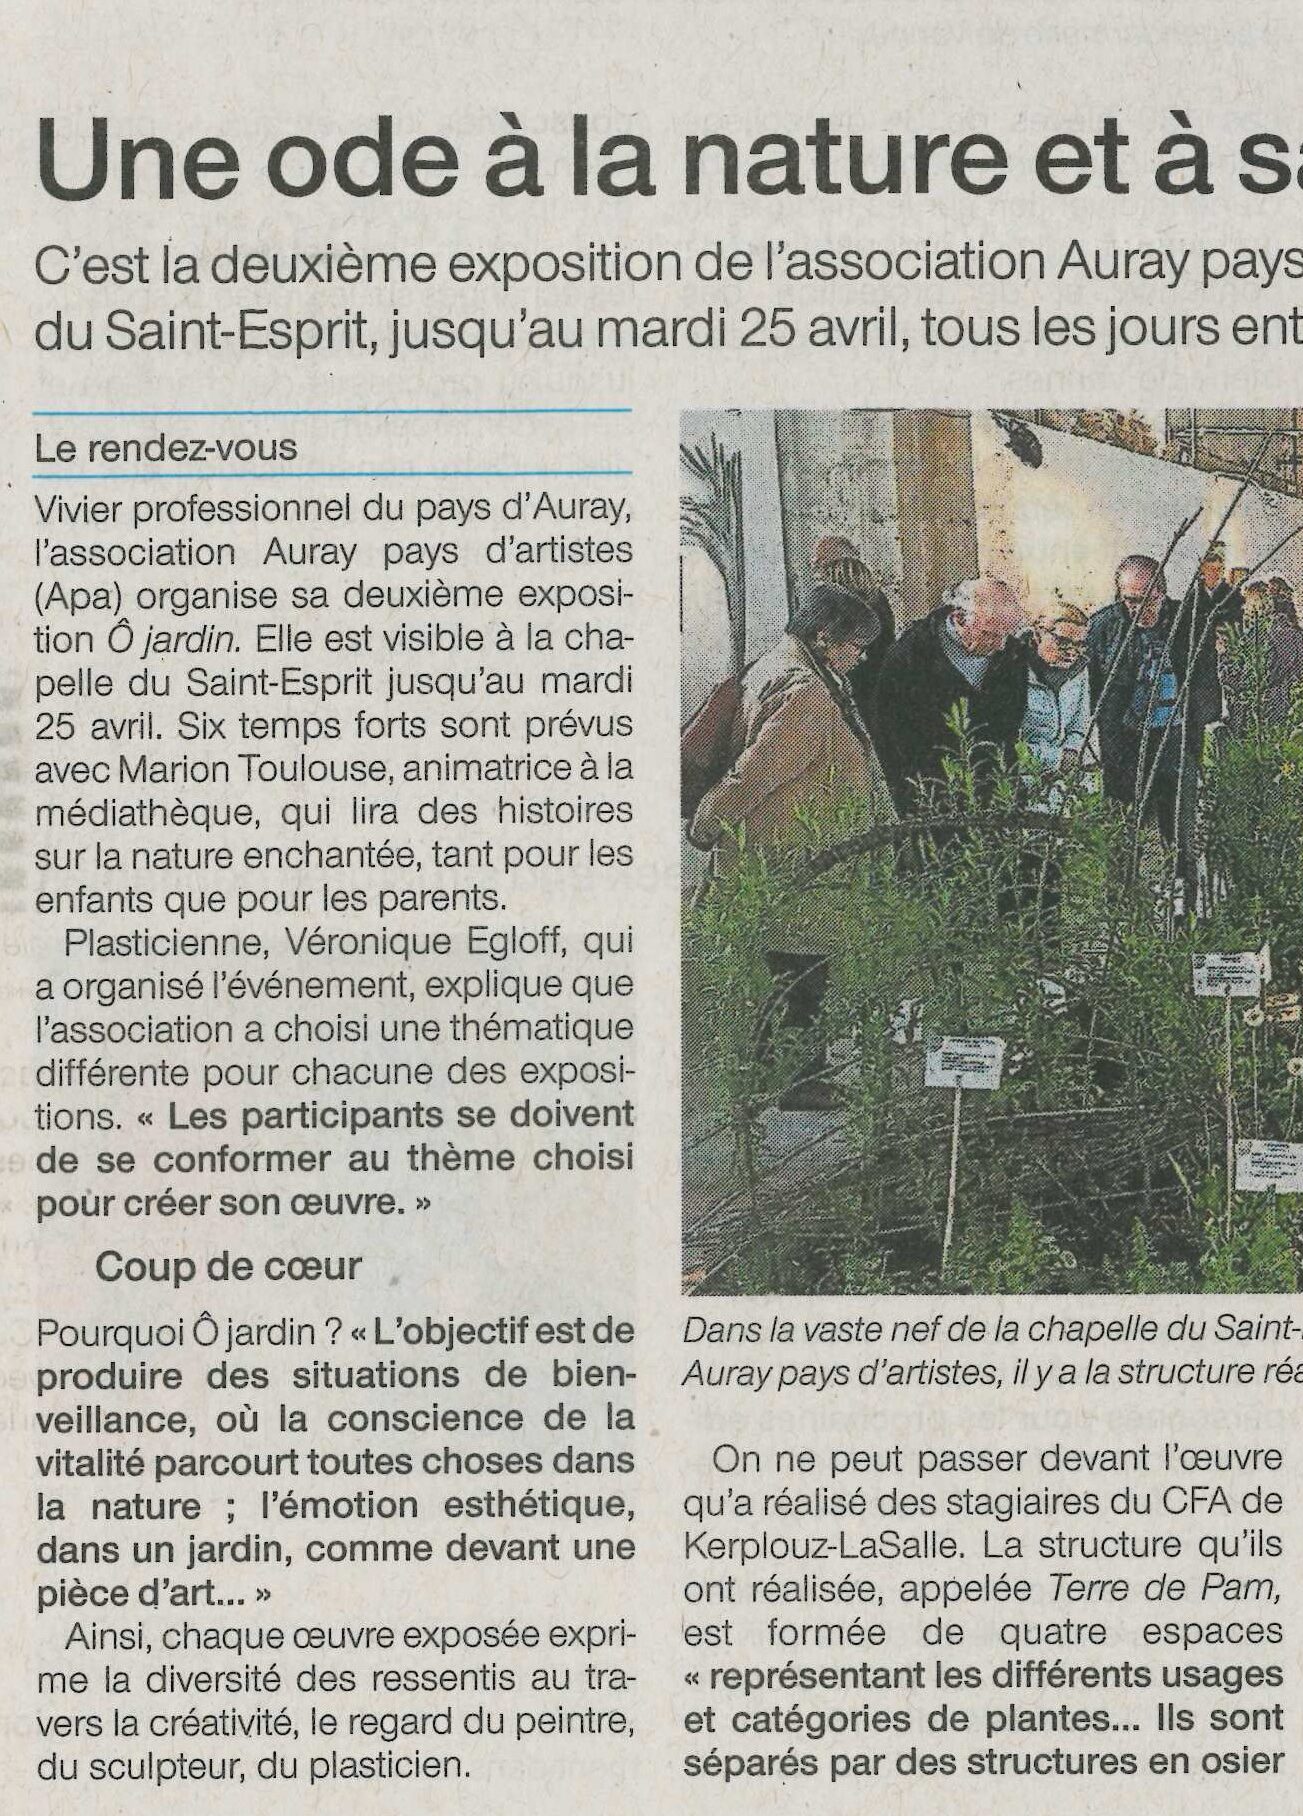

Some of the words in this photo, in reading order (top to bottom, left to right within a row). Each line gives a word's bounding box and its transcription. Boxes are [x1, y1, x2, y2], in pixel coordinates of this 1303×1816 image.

[39, 116, 240, 202] Une
[267, 114, 459, 198] ode
[485, 111, 545, 198] à
[573, 113, 657, 197] la
[685, 117, 1009, 196] nature
[1035, 117, 1130, 195] et
[1154, 109, 1215, 196] à
[35, 244, 150, 285] C'est
[163, 244, 200, 285] la
[211, 241, 437, 284] deuxième
[449, 241, 682, 292] exposition
[695, 241, 753, 281] de
[767, 239, 1045, 281] l'association
[1057, 239, 1191, 289] Auray
[35, 310, 92, 351] du
[106, 308, 378, 360] Saint-Esprit,
[388, 307, 583, 359] jusqu'au
[598, 306, 725, 348] mardi
[740, 306, 796, 347] 25
[809, 305, 909, 353] avril,
[920, 307, 1020, 347] tous
[1034, 305, 1096, 347] les
[1105, 305, 1220, 356] jours
[36, 433, 77, 463] Le
[89, 432, 298, 463] rendez-vous
[34, 494, 123, 523] Vivier
[134, 492, 350, 530] professionnel
[363, 492, 403, 521] du
[417, 498, 491, 528] pays
[502, 491, 631, 527] d'Auray,
[65, 927, 269, 961] Plasticienne,
[284, 925, 452, 962] Véronique
[468, 925, 567, 962] Egloff,
[583, 925, 633, 960] qui
[36, 1057, 189, 1087] différente
[204, 1064, 280, 1093] pour
[292, 1057, 433, 1086] chacune
[447, 1055, 507, 1085] des
[520, 1054, 636, 1091] exposi-
[95, 1250, 197, 1289] Coup
[207, 1250, 254, 1282] de
[264, 1256, 363, 1281] cœur
[683, 1316, 762, 1343] Dans
[769, 1315, 795, 1343] la
[804, 1316, 883, 1343] vaste
[890, 1314, 943, 1342] nef
[948, 1314, 986, 1342] de
[994, 1314, 1019, 1342] la
[1028, 1314, 1159, 1348] chapelle
[1167, 1313, 1207, 1341] du
[37, 1361, 183, 1397] produire
[206, 1360, 269, 1390] des
[293, 1359, 460, 1389] situations
[485, 1359, 528, 1388] de
[553, 1358, 637, 1388] bien-
[680, 1359, 774, 1393] Auray
[777, 1364, 851, 1392] pays
[858, 1358, 1003, 1390] d'artistes,
[1013, 1357, 1029, 1385] il
[1033, 1364, 1054, 1392] y
[1058, 1364, 1076, 1385] a
[1085, 1357, 1110, 1385] la
[1118, 1358, 1255, 1385] structure
[684, 1621, 733, 1647] est
[767, 1616, 886, 1646] formée
[922, 1616, 964, 1646] de
[1000, 1618, 1107, 1652] quatre
[1143, 1622, 1283, 1651] espaces
[38, 1671, 89, 1694] me
[105, 1665, 132, 1694] la
[146, 1662, 281, 1694] diversité
[296, 1663, 357, 1693] des
[373, 1663, 516, 1692] ressentis
[531, 1669, 570, 1691] au
[584, 1665, 637, 1691] tra-
[37, 1751, 78, 1781] du
[89, 1751, 245, 1787] sculpteur,
[257, 1750, 297, 1780] du
[310, 1749, 470, 1786] plasticien.
[683, 1746, 819, 1783] séparés
[831, 1754, 886, 1783] par
[895, 1746, 957, 1776] des
[967, 1747, 1138, 1775] structures
[1148, 1752, 1190, 1775] en
[1201, 1745, 1286, 1775] osier
